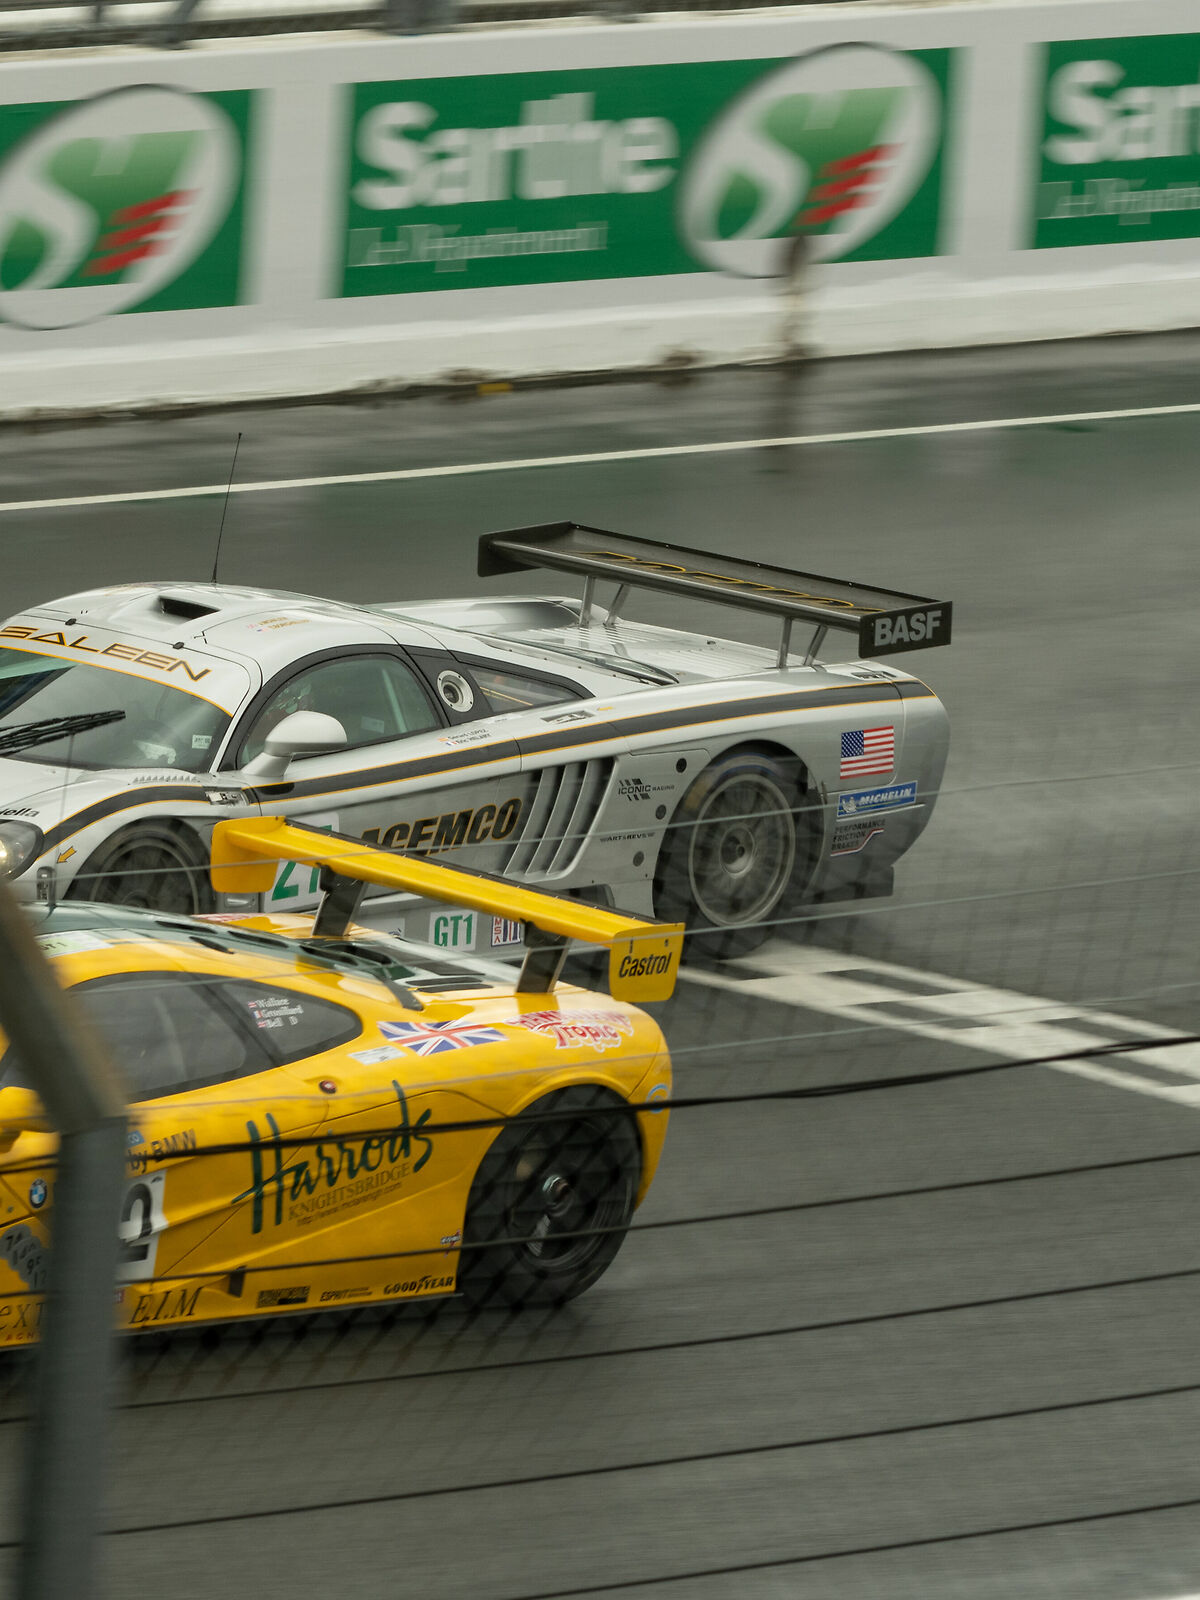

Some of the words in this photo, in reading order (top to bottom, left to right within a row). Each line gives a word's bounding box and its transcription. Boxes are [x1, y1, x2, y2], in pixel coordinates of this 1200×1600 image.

[1045, 59, 1200, 165] Sar
[353, 93, 678, 211] Sarthe
[873, 610, 942, 647] BASF
[618, 785, 651, 795] ICONIC
[859, 788, 912, 806] MICHELIN
[833, 832, 866, 842] FRICTION
[434, 913, 474, 947] GT1
[619, 952, 672, 978] Castrol
[555, 1022, 621, 1049] Tropic
[232, 1080, 432, 1234] Harrods
[384, 1275, 454, 1295] GOODYEAR
[129, 1287, 200, 1325] E.I.M
